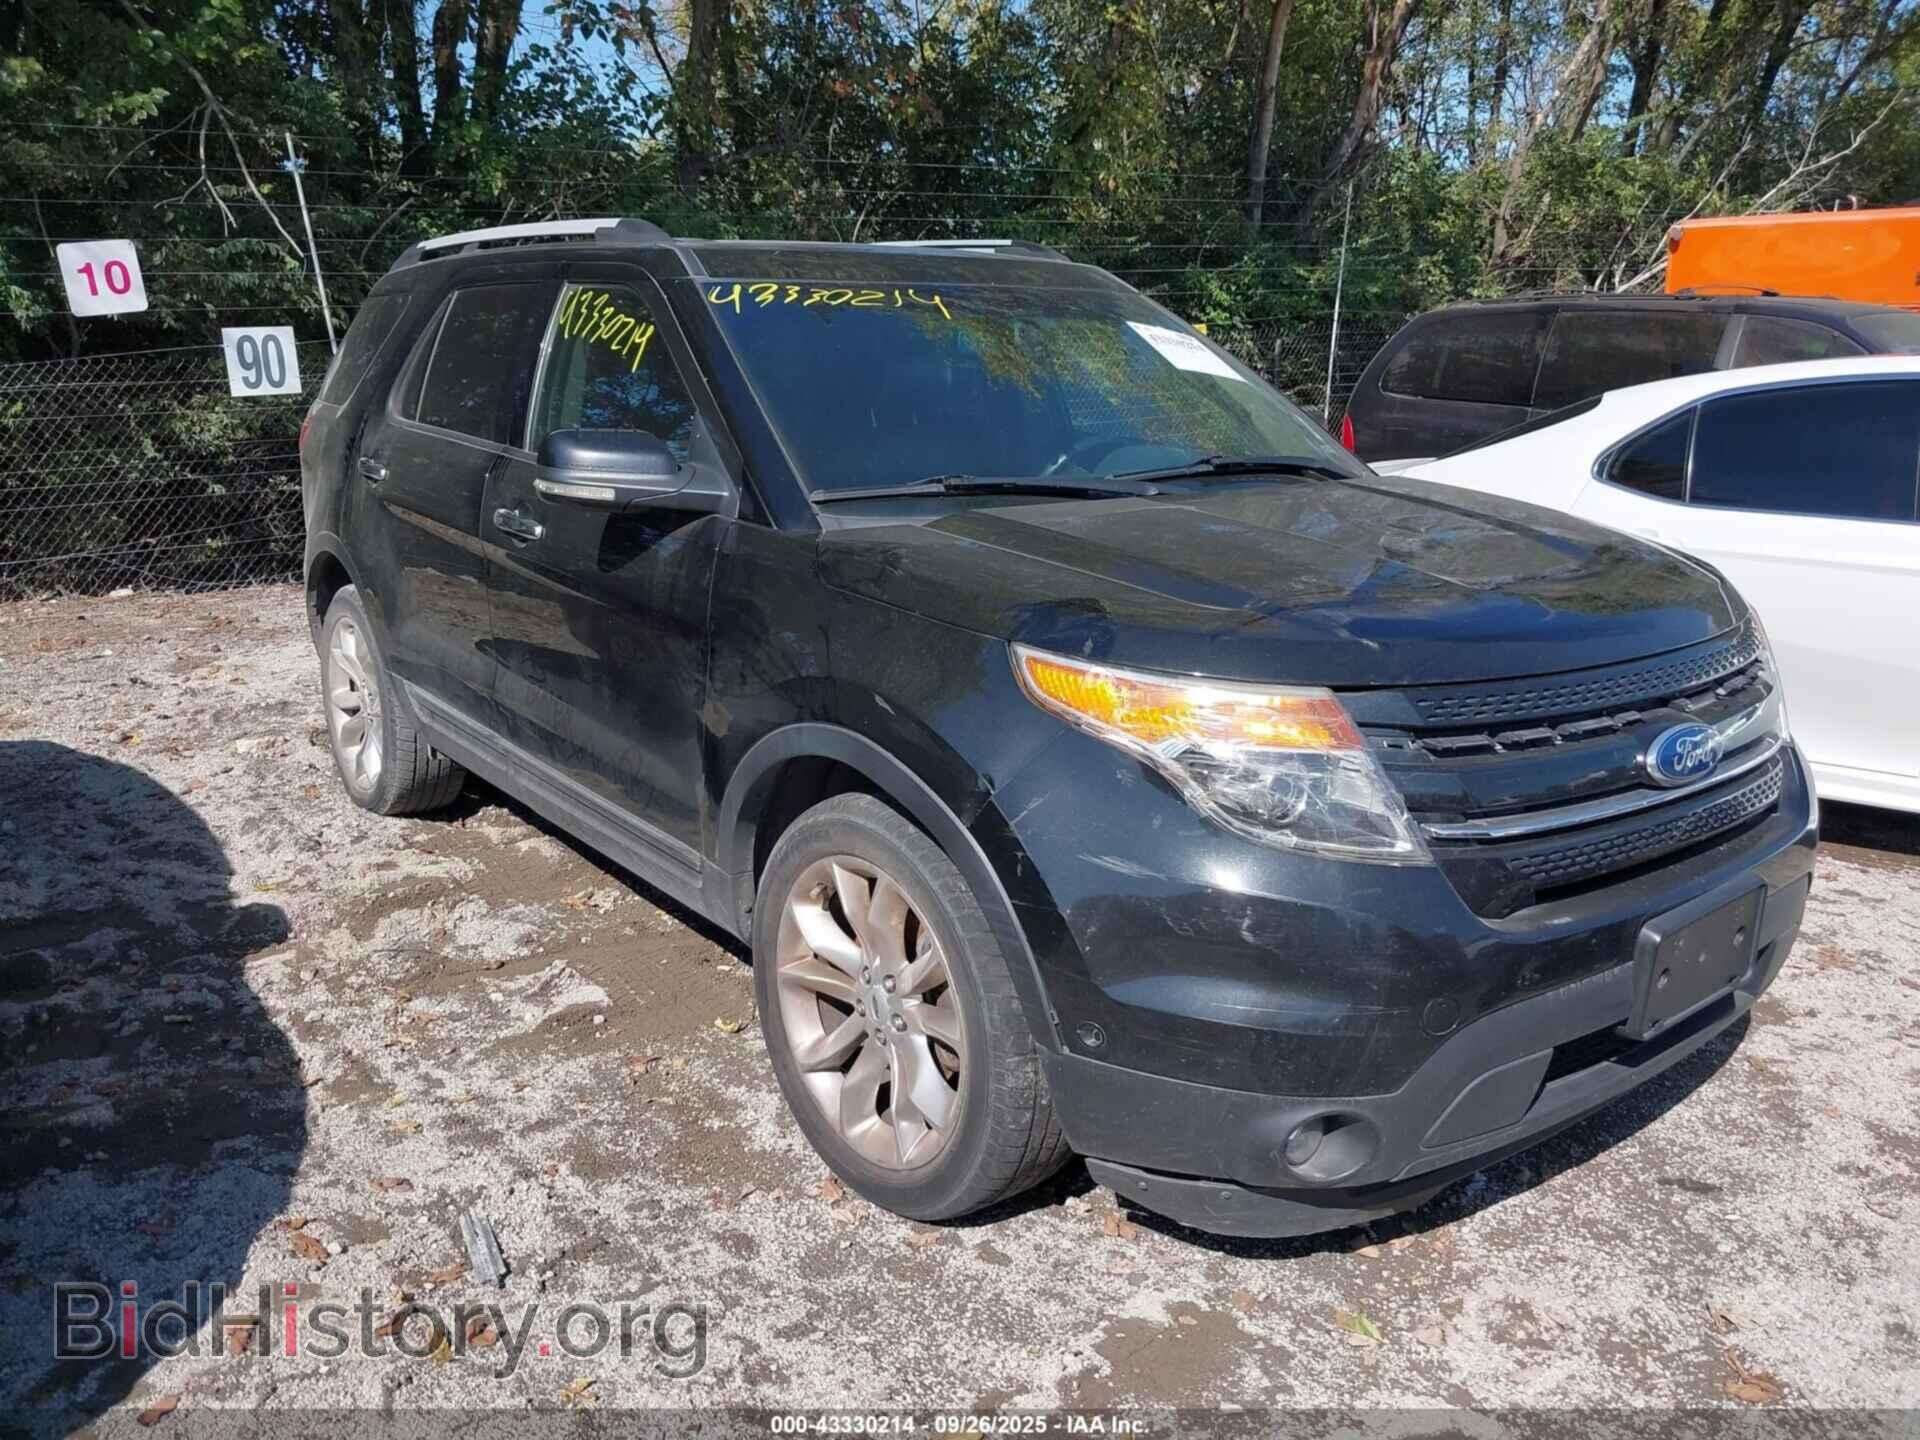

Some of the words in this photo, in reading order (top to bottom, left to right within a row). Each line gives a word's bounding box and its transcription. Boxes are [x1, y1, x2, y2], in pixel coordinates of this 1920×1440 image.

[77, 260, 132, 296] 10
[707, 283, 951, 320] 43330214
[560, 286, 655, 373] 43330214
[236, 333, 286, 389] 90
[1673, 732, 1714, 772] Ford
